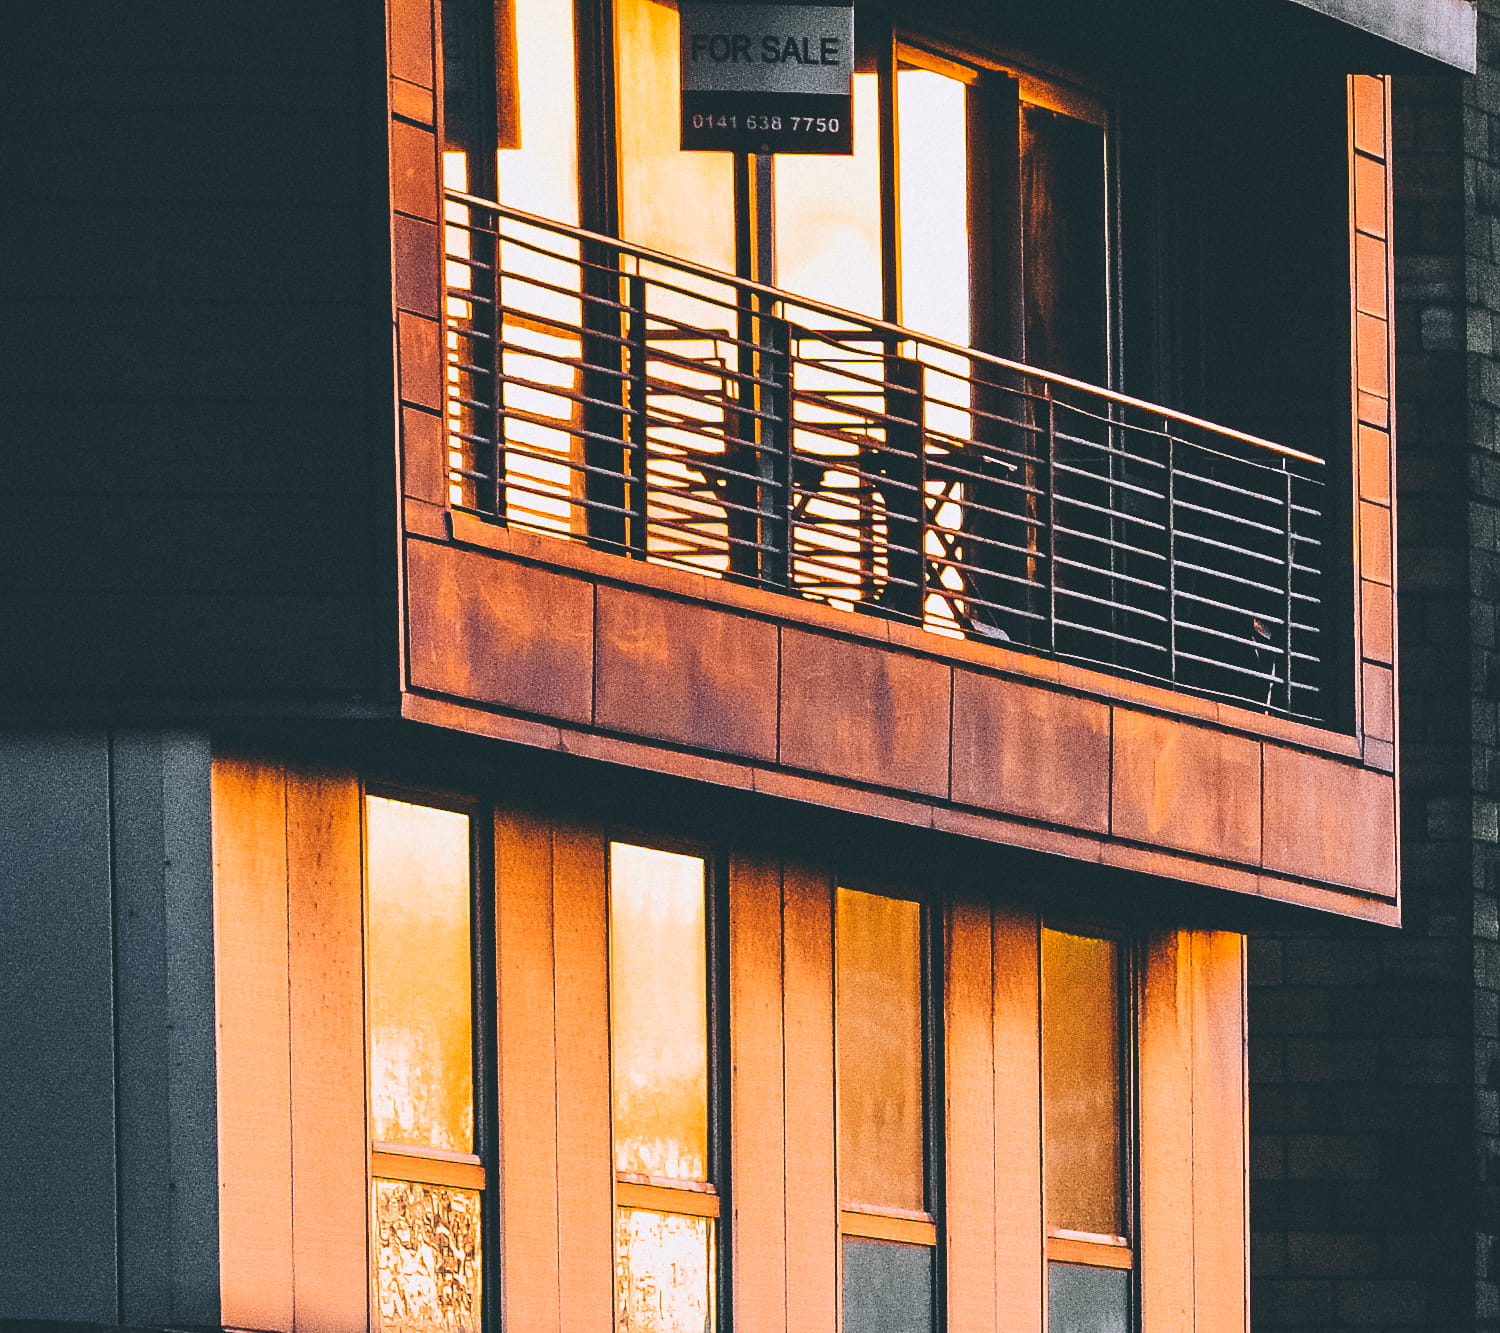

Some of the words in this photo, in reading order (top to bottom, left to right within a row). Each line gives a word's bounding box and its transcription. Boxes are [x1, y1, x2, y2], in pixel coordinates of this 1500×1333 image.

[690, 33, 753, 64] FOR
[761, 36, 841, 67] SALE
[692, 113, 738, 130] 0141
[746, 115, 782, 131] 638
[790, 116, 840, 133] 7750
